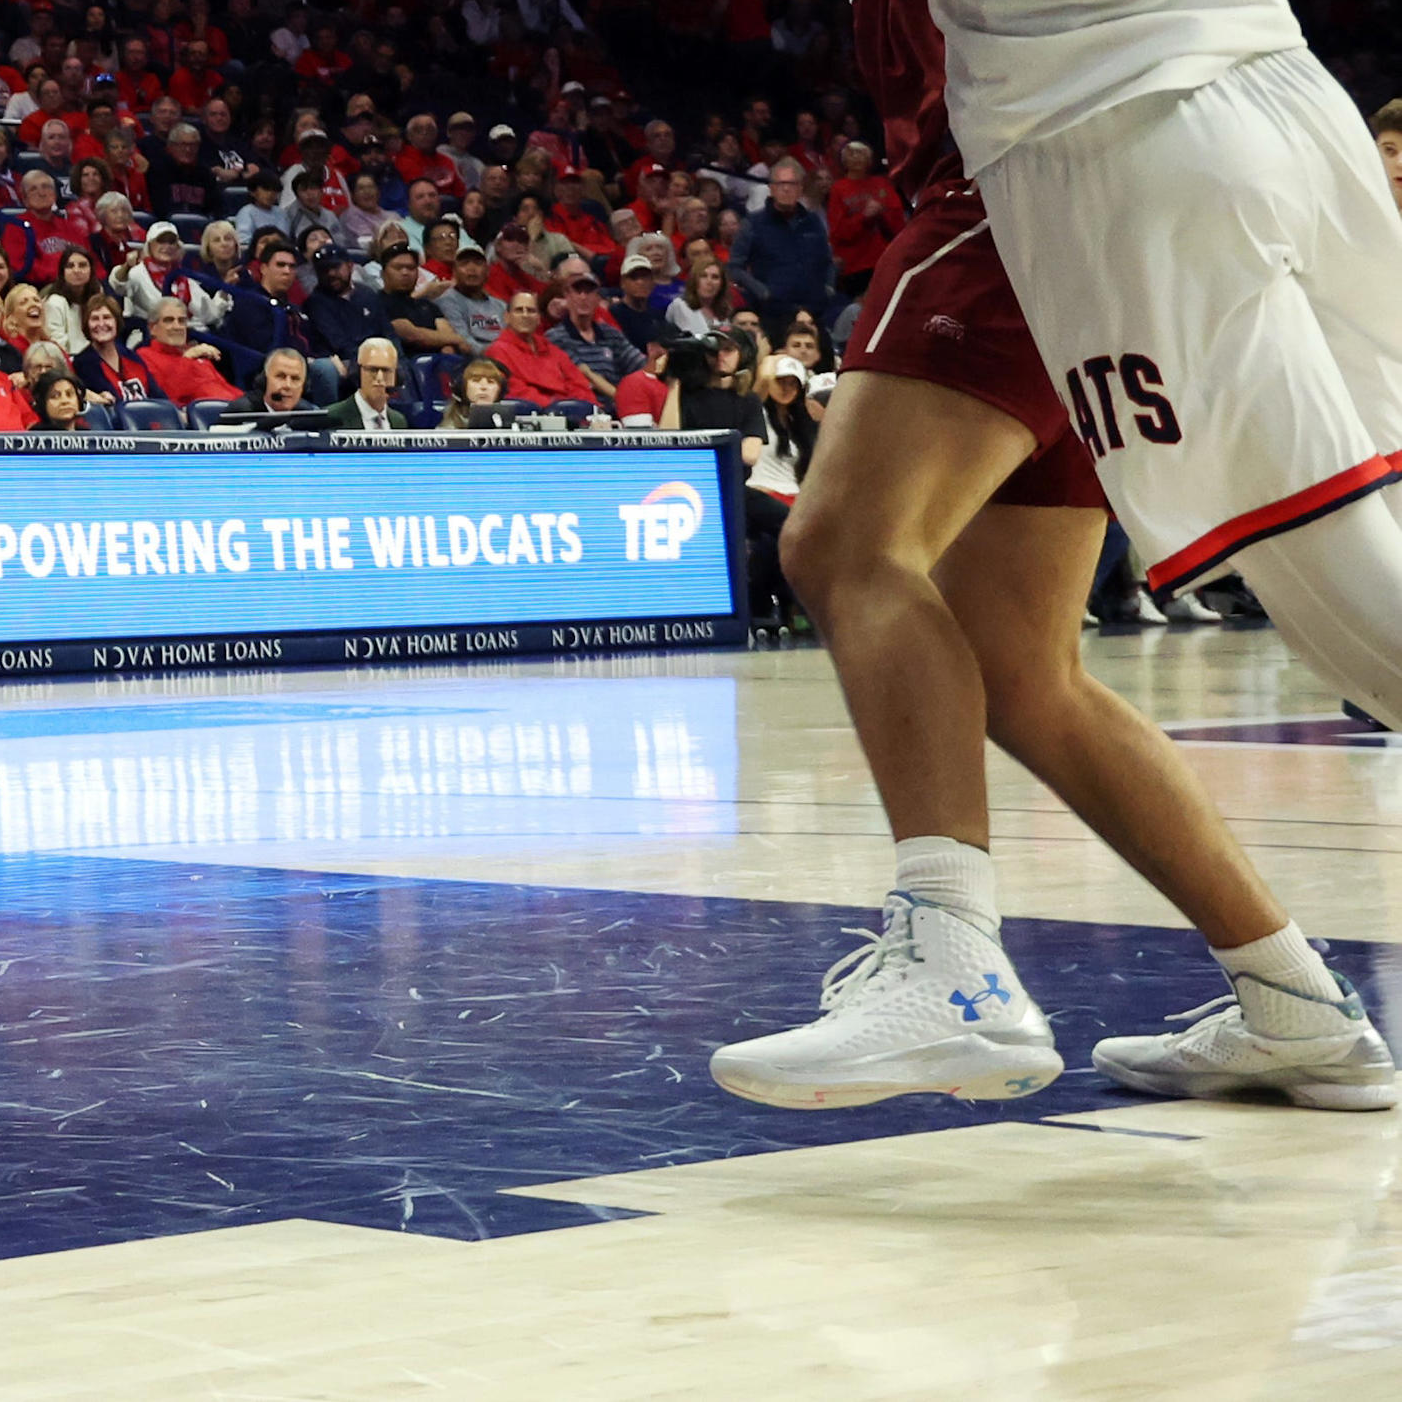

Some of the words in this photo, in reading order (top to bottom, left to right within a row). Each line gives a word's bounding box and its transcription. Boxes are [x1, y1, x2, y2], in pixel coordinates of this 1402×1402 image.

[1062, 352, 1183, 459] ATS
[50, 434, 90, 450] HOME
[94, 434, 137, 450] LOANS
[262, 516, 355, 572] THE
[363, 511, 584, 569] WILDCATS
[618, 502, 696, 562] TEP
[407, 632, 458, 656] HOME
[466, 629, 519, 651] LOANS
[609, 623, 656, 645] HOME
[663, 620, 715, 641] LOANS
[162, 642, 217, 666] HOME
[225, 639, 283, 661] LOANS
